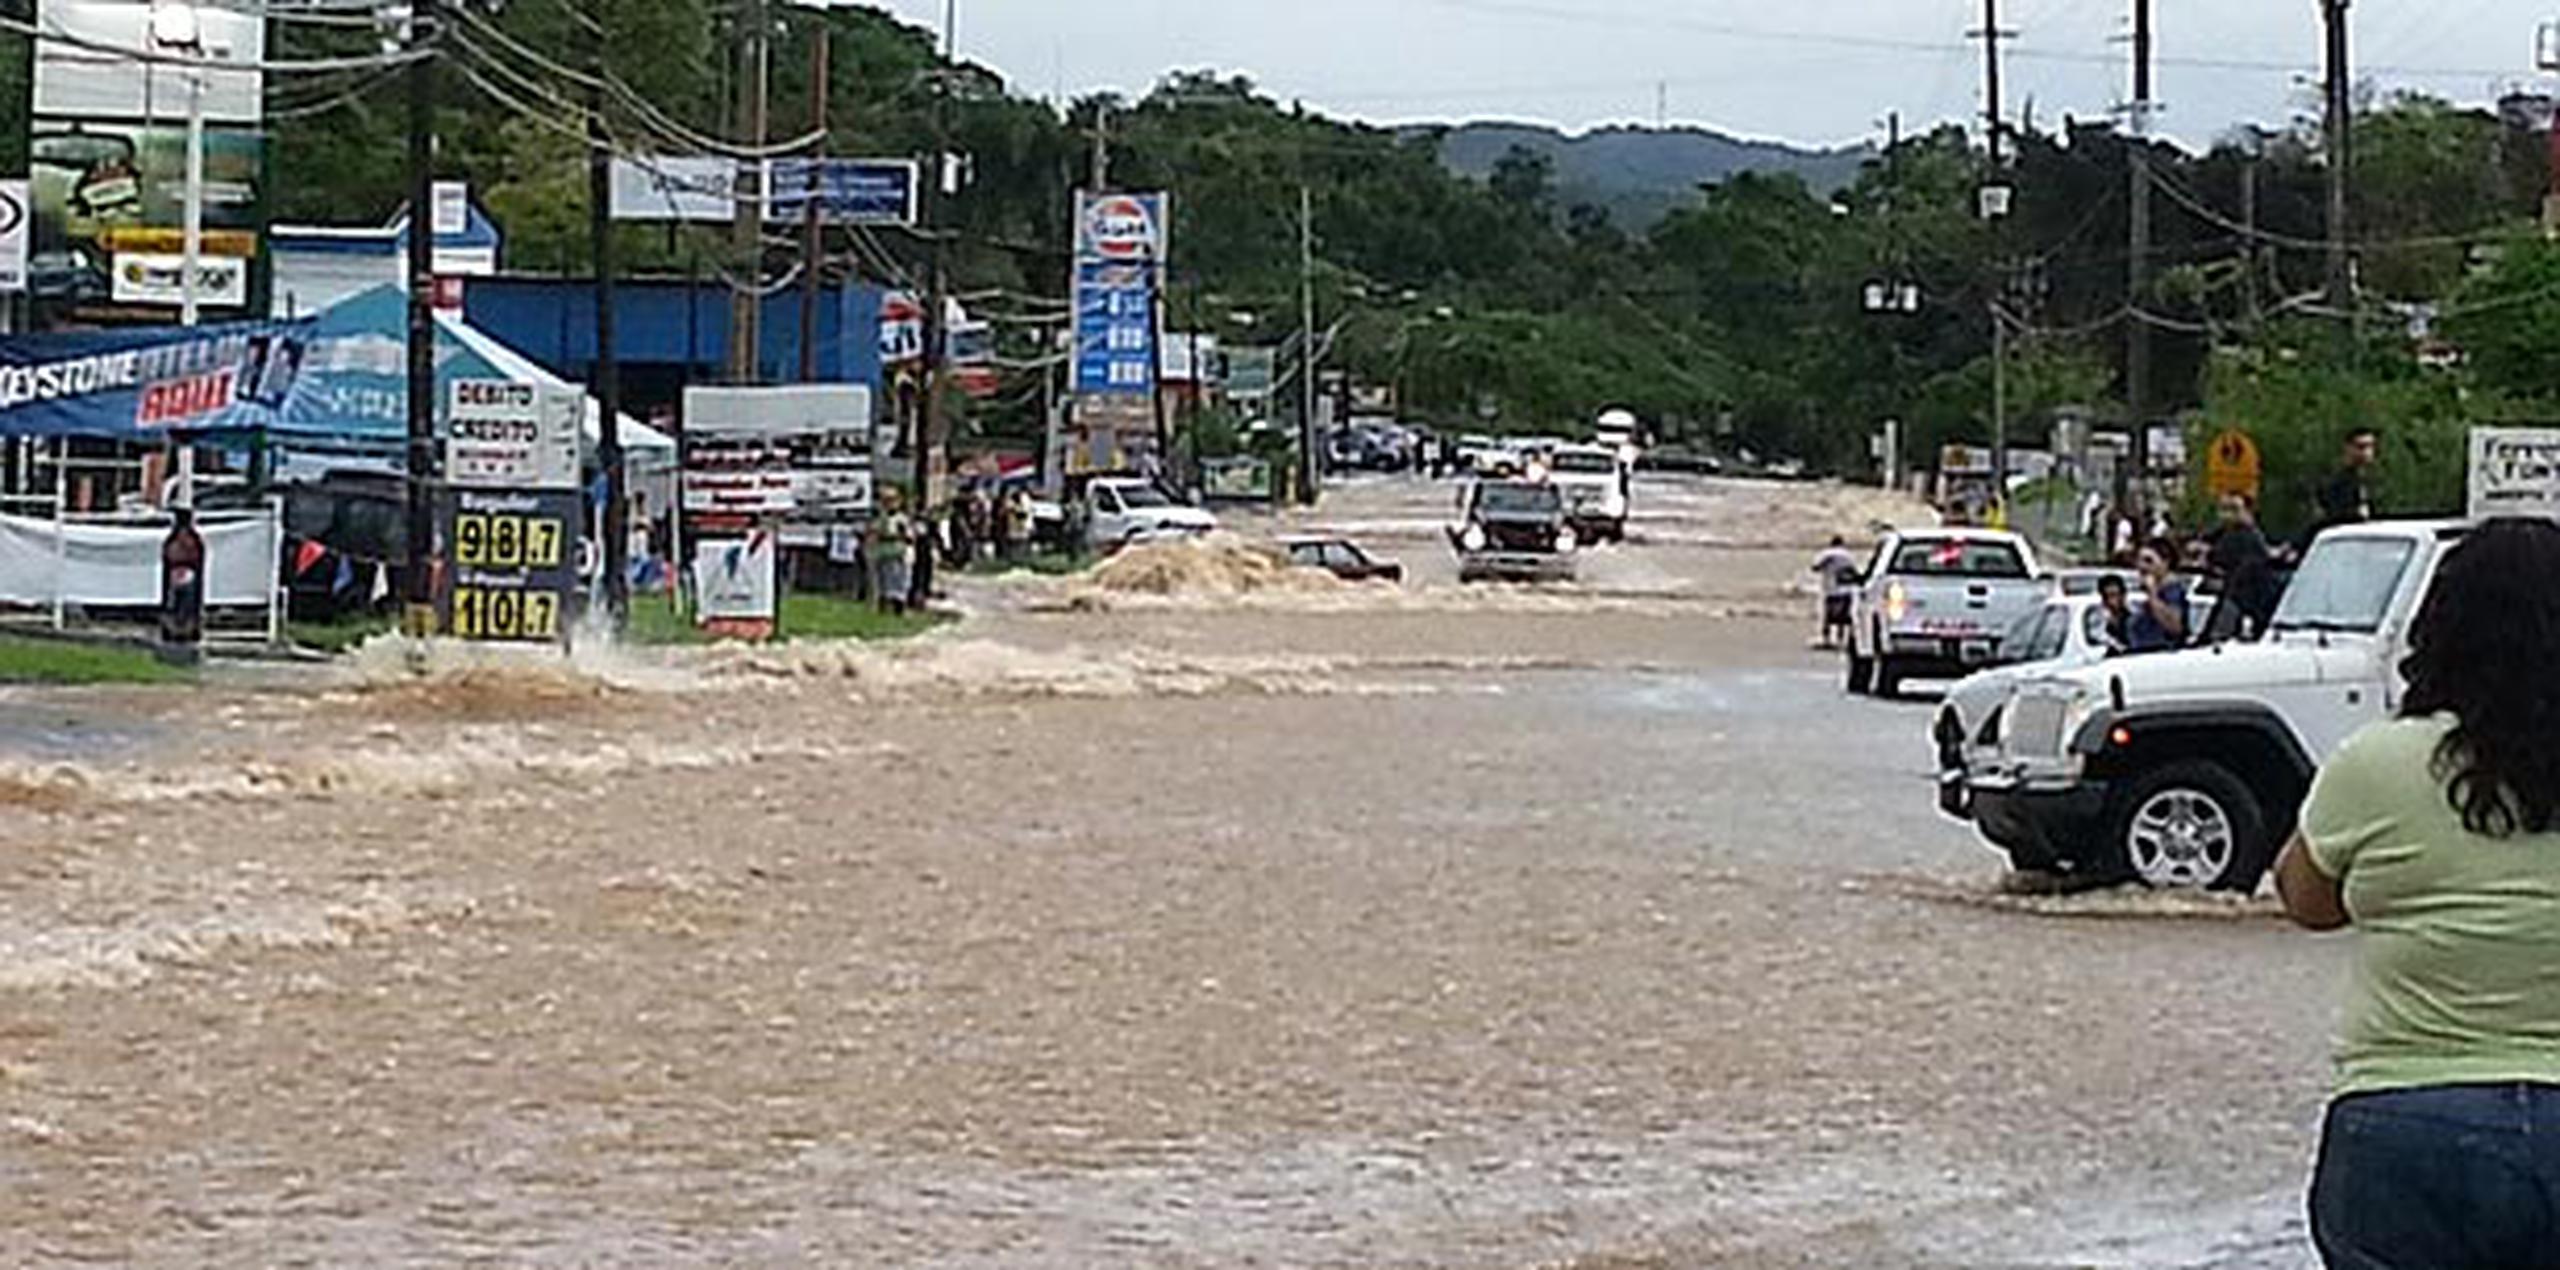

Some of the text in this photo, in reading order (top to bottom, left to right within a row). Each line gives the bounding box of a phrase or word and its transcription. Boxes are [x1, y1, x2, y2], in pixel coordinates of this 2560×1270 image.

[138, 368, 236, 422] AQUI
[459, 384, 532, 405] DEBITO
[450, 418, 538, 442] CREDITO
